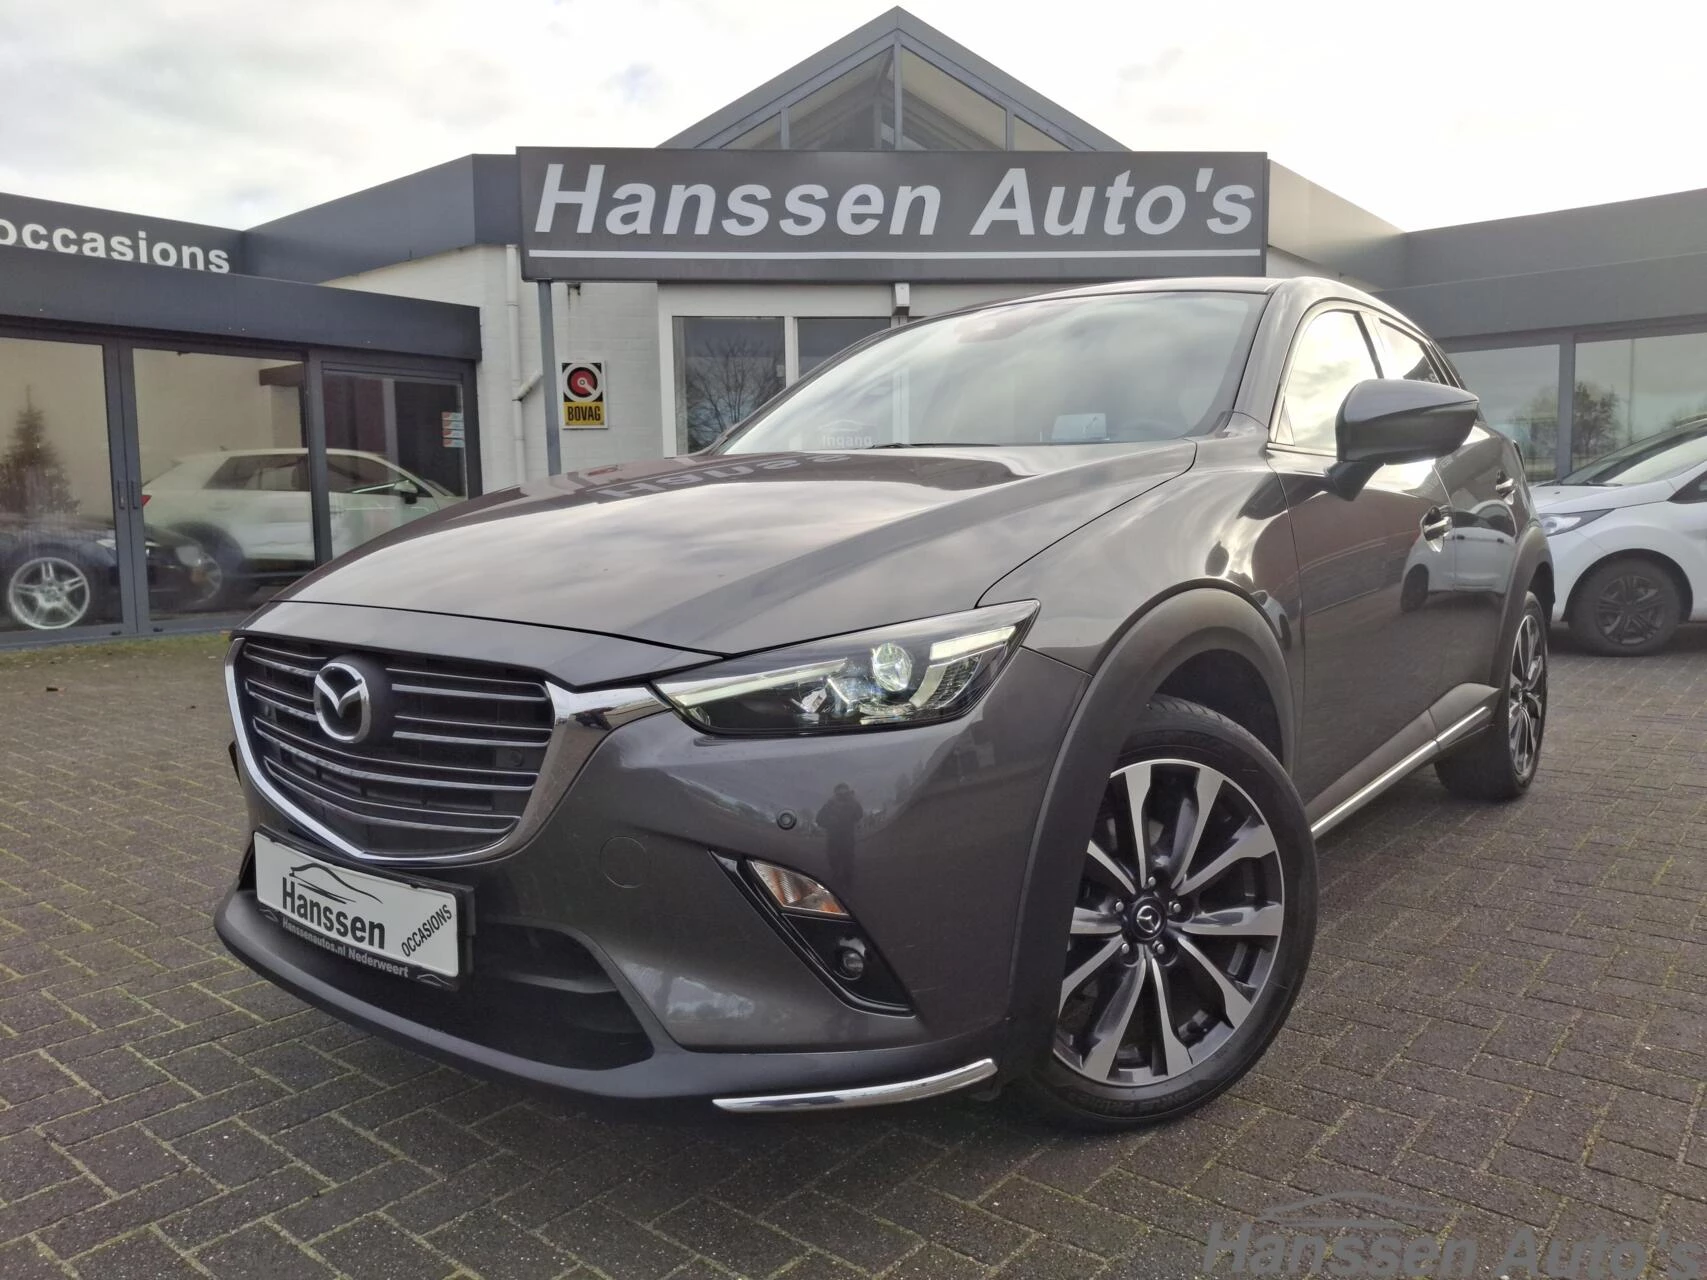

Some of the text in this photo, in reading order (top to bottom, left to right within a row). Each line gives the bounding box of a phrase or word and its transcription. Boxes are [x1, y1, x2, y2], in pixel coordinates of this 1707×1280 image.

[534, 163, 1254, 236] Hanssen Auto's
[0, 218, 230, 274] occasions
[567, 405, 602, 421] BOVAG
[282, 877, 386, 950] Hanssen
[401, 904, 453, 958] OCCASIONS
[282, 916, 409, 978] Hanssenautos.nl Nederweert
